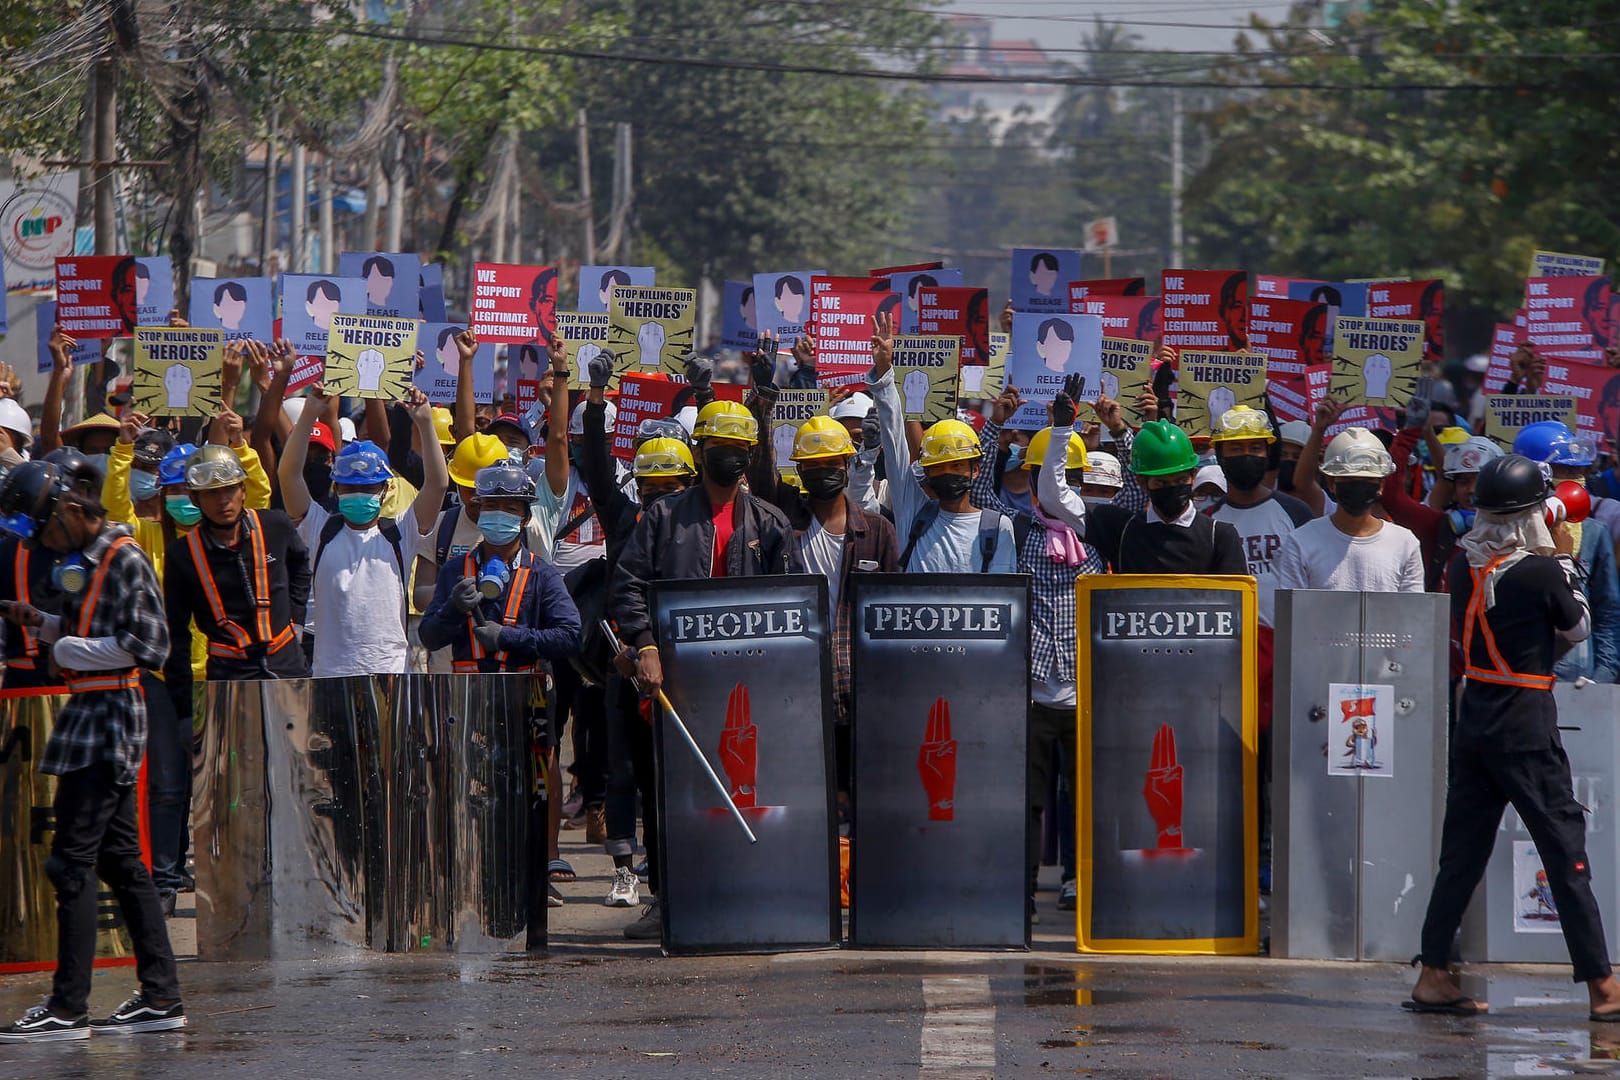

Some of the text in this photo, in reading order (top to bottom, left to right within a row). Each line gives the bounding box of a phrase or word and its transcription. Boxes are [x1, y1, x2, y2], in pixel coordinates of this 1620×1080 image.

[58, 264, 77, 276] WE
[477, 270, 496, 283] WE
[60, 280, 102, 290] SUPPORT
[1165, 277, 1184, 290] WE
[1259, 280, 1276, 292] WE
[1529, 283, 1549, 295] WE
[476, 286, 522, 298] SUPPORT
[615, 289, 692, 301] STOP KILLING OUR
[1071, 287, 1088, 299] WE
[1372, 290, 1390, 303] WE
[60, 294, 79, 304] OUR
[475, 299, 495, 310] OUR
[821, 297, 840, 309] WE
[921, 294, 937, 305] WE
[1165, 294, 1210, 304] SUPPORT
[1529, 298, 1575, 308] SUPPORT
[60, 306, 111, 317] LEGITIMATE
[1087, 302, 1105, 313] WE
[1164, 308, 1184, 318] OUR
[1252, 304, 1270, 317] WE
[1372, 304, 1412, 317] SUPPORT
[475, 311, 528, 324] LEGITIMATE
[556, 315, 608, 324] STOP KILLING
[821, 313, 866, 324] SUPPORT
[922, 310, 959, 320] SUPPORT
[1528, 311, 1549, 320] OUR
[60, 319, 122, 331] GOVERNMENT
[334, 317, 414, 331] STOP KILLING OUR
[922, 322, 938, 331] OUR
[1164, 321, 1218, 332] LEGITIMATE
[1250, 320, 1293, 333] SUPPORT
[1338, 320, 1420, 334] STOP KILLING OUR
[1528, 322, 1583, 333] LEGITIMATE
[474, 324, 538, 337] GOVERNMENT
[558, 326, 608, 341] “HEROE
[820, 327, 840, 336] OUR
[138, 332, 218, 342] STOP KILLING OUR
[223, 332, 253, 341] LEASE
[1164, 335, 1229, 346] GOVERNMENT
[1250, 333, 1268, 344] OUR
[1497, 330, 1515, 343] WE
[819, 340, 872, 351] LEGITIMATE
[904, 340, 936, 348] KILLING
[938, 340, 955, 348] OUR
[1131, 344, 1150, 354] OUR
[1184, 354, 1263, 367] STOP KILLING OUR
[1308, 371, 1328, 385] WE
[1549, 365, 1569, 380] WE
[519, 386, 535, 397] WE
[622, 382, 640, 396] WE
[807, 393, 825, 401] OUR
[620, 399, 662, 414] SUPPORT
[1490, 398, 1572, 409] STOP KILLING OUR
[619, 411, 637, 422] OUR
[676, 609, 803, 639] PEOPLE
[875, 607, 1001, 631] PEOPLE
[1107, 612, 1233, 636] PEOPLE
